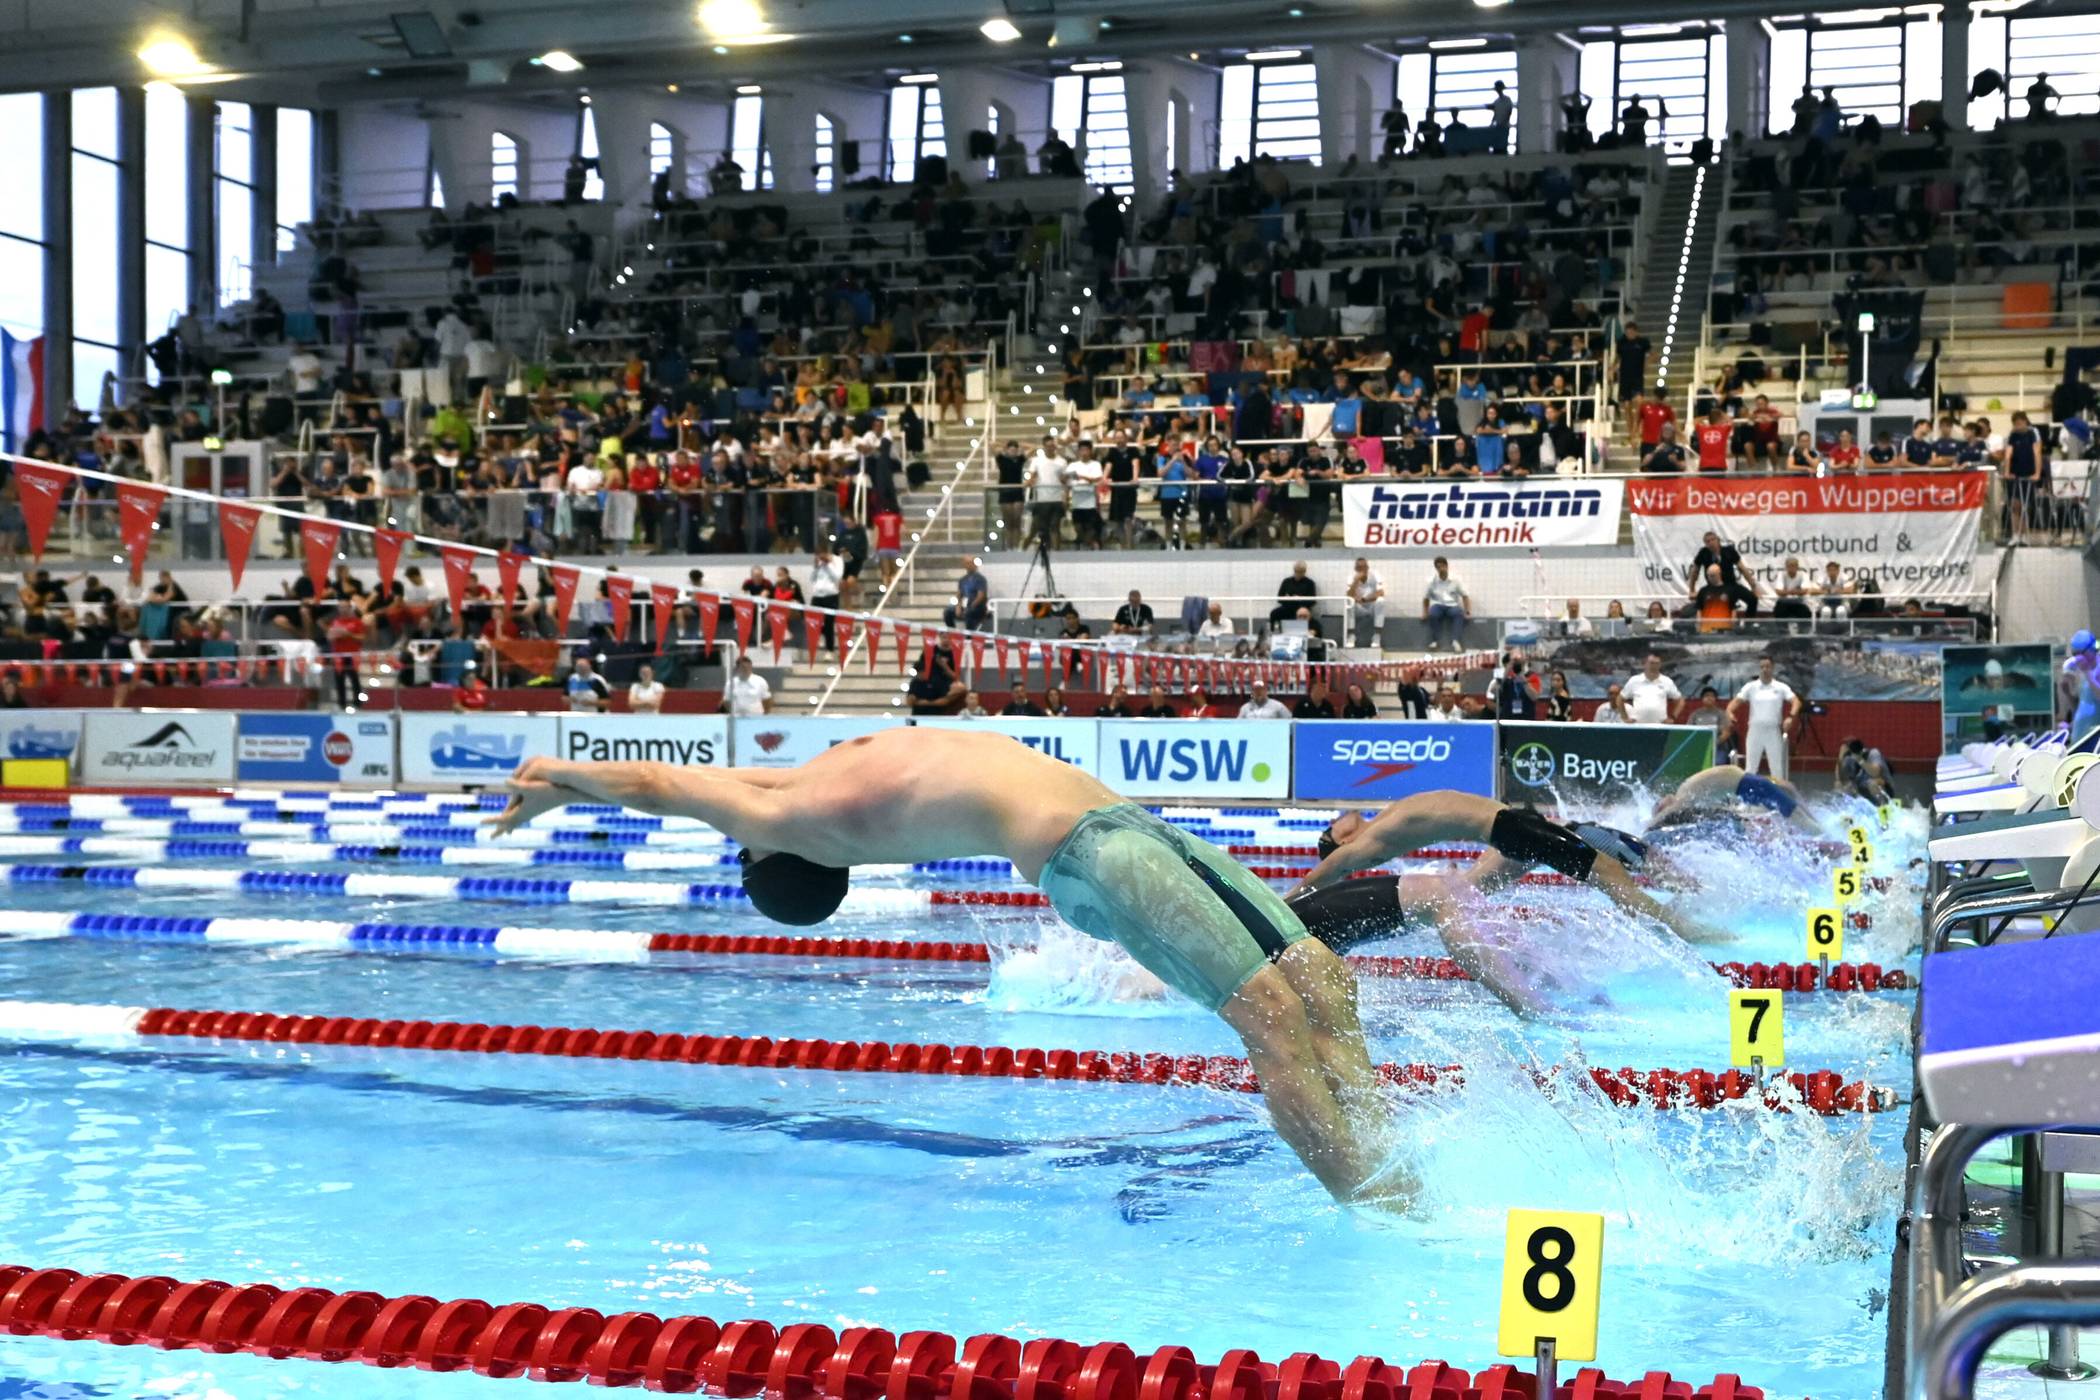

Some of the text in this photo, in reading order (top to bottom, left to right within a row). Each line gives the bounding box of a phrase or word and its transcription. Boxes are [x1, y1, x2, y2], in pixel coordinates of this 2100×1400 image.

[1368, 485, 1601, 519] hartmann
[1631, 487, 1677, 510] Wir
[1687, 485, 1807, 513] bewegen
[1819, 482, 1964, 512] Wuppertal
[1364, 521, 1535, 545] Bürotechnik
[1726, 532, 1913, 558] dtsportbund &
[1645, 562, 1673, 582] die
[101, 748, 216, 772] aquafeel
[569, 730, 715, 765] Pammys
[1120, 738, 1248, 783] WSW
[1332, 735, 1451, 766] speedo
[1563, 753, 1638, 784] Bayer
[1851, 829, 1863, 844] 3
[1838, 872, 1855, 896] 5
[1813, 914, 1835, 945] 6
[1740, 999, 1770, 1044] 7
[1522, 1226, 1576, 1314] 8
